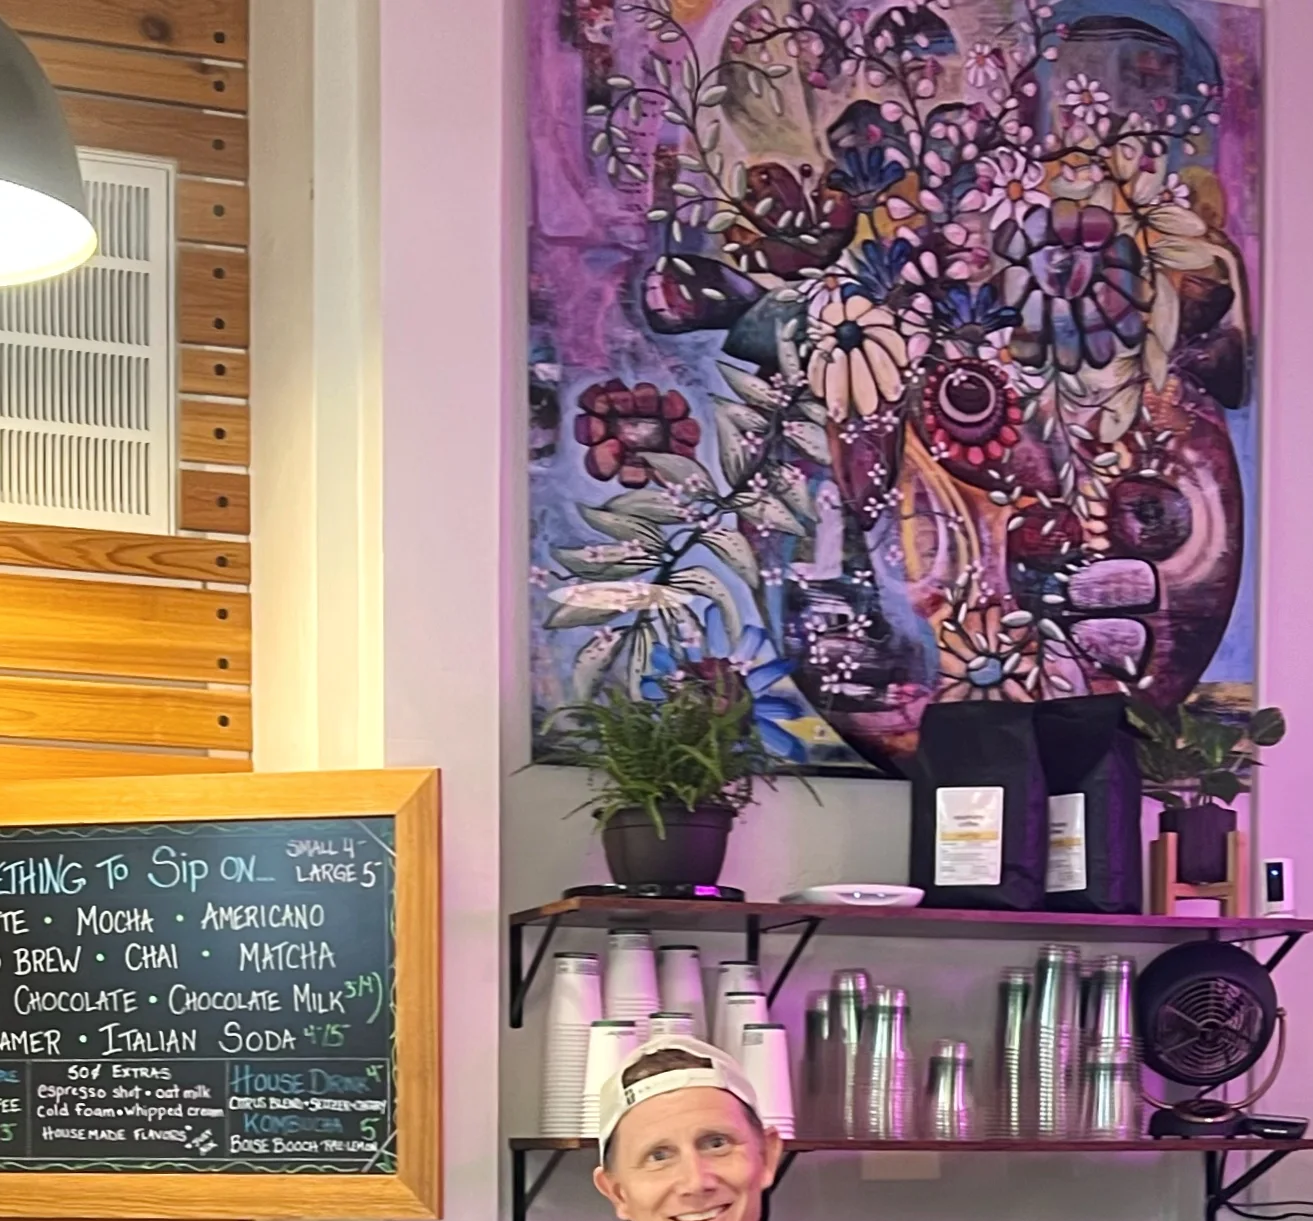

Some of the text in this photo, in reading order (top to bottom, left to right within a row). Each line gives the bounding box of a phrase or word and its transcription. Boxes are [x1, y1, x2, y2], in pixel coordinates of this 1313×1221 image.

[286, 839, 338, 857] SMALL
[295, 863, 357, 884] LARGE
[77, 905, 154, 936] MOCHA
[201, 902, 325, 930] AMERICANO
[13, 946, 82, 975] BREW
[125, 943, 179, 971] CHAI
[239, 941, 336, 973] MATCHA
[14, 984, 138, 1015] CHOCOLATE
[168, 983, 282, 1015] CHOCOLATE
[293, 983, 345, 1014] MILK
[98, 1022, 197, 1056] ITALIAN
[219, 1021, 296, 1053] SODA
[112, 1064, 172, 1081] EXTRAS
[230, 1065, 305, 1095] HOUSE
[37, 1084, 211, 1103] espresso shot oat milk
[37, 1104, 70, 1118] cold
[75, 1104, 115, 1117] foam
[124, 1104, 183, 1122] whipped
[229, 1134, 272, 1154] BOISE
[272, 1137, 319, 1154] BOOCH
